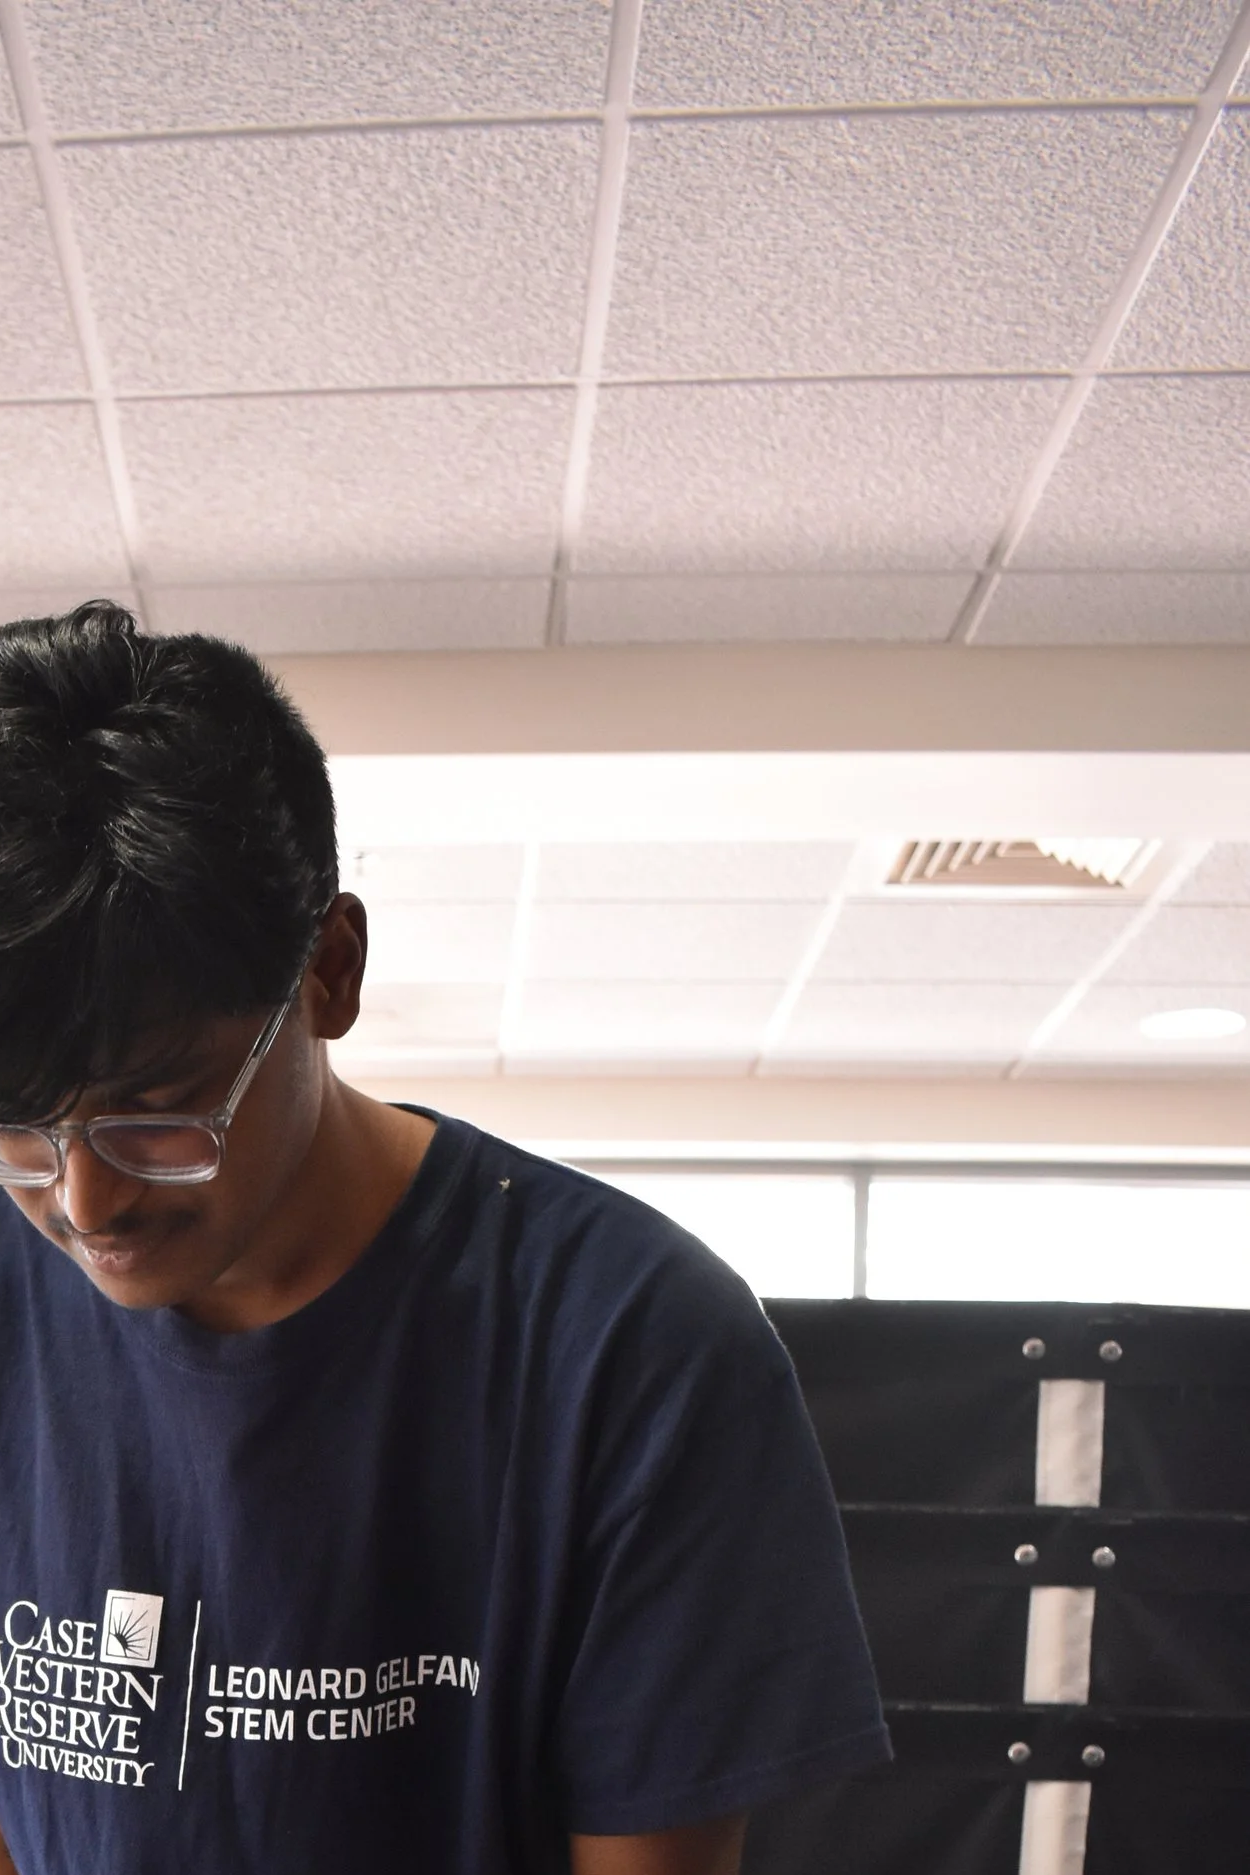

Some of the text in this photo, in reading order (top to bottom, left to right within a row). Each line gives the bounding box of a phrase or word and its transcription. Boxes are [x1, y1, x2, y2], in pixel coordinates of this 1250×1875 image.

[5, 1600, 97, 1661] CASE
[208, 1654, 480, 1700] LEONARD GELFAN
[204, 1696, 416, 1741] STEM CENTER
[0, 1735, 155, 1787] UNIVERSITY
